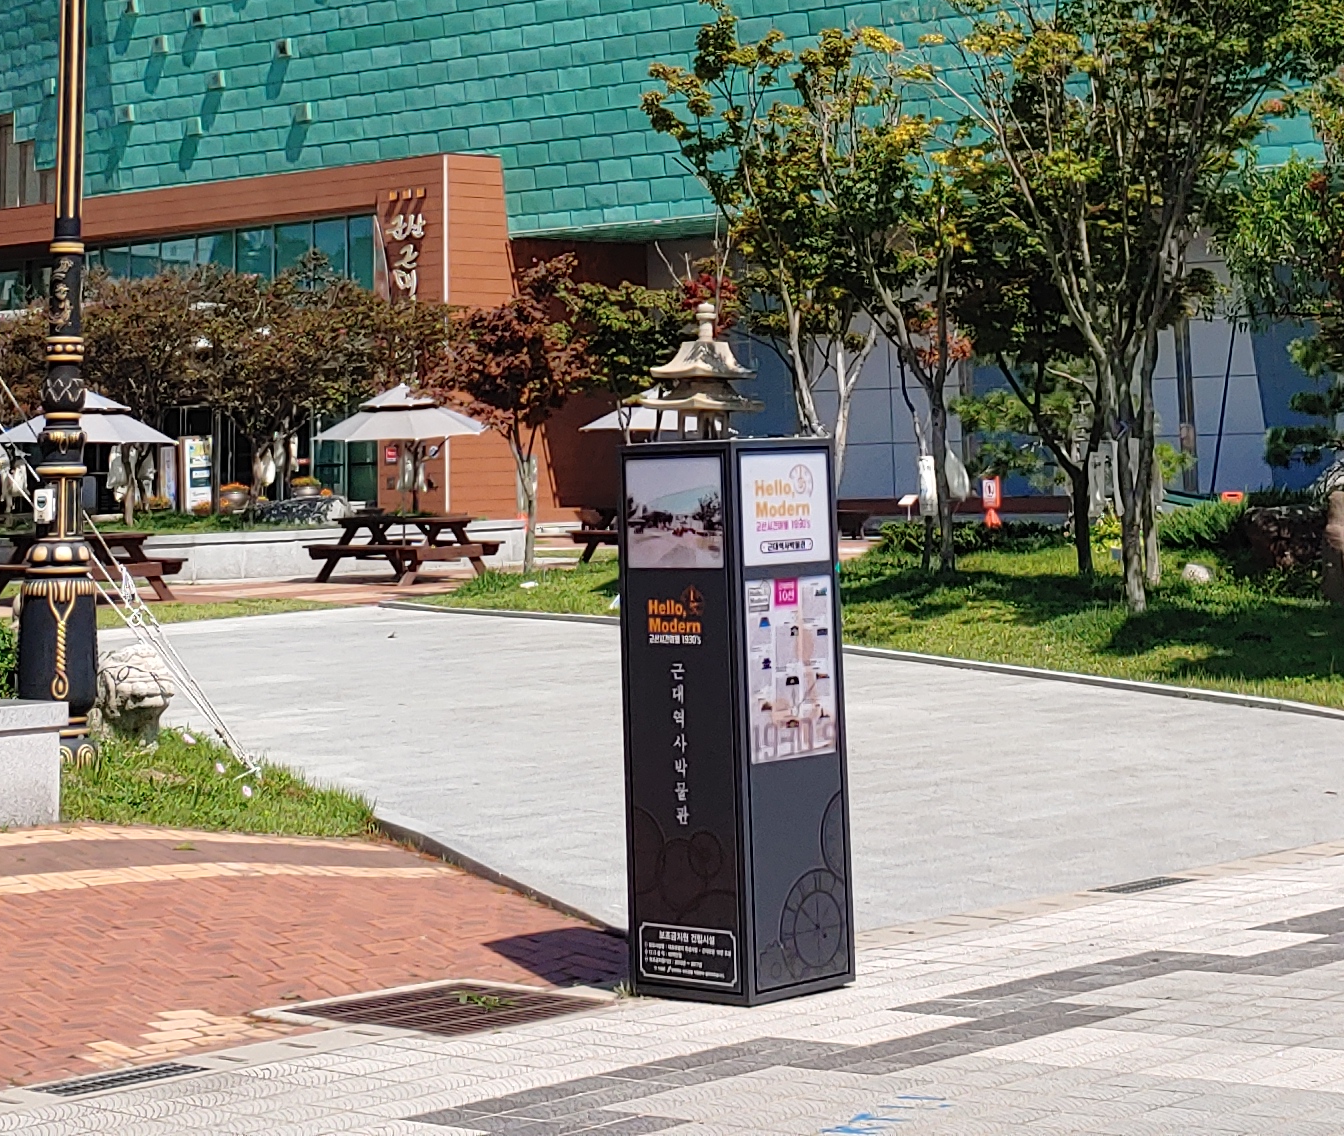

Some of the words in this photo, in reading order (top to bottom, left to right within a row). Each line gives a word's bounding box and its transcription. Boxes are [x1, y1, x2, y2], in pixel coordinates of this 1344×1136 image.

[755, 479, 795, 498] Hello,
[756, 500, 810, 518] Modern
[648, 599, 687, 619] Hello,
[648, 617, 701, 633] Modern
[670, 663, 690, 825] 근대역사박물관
